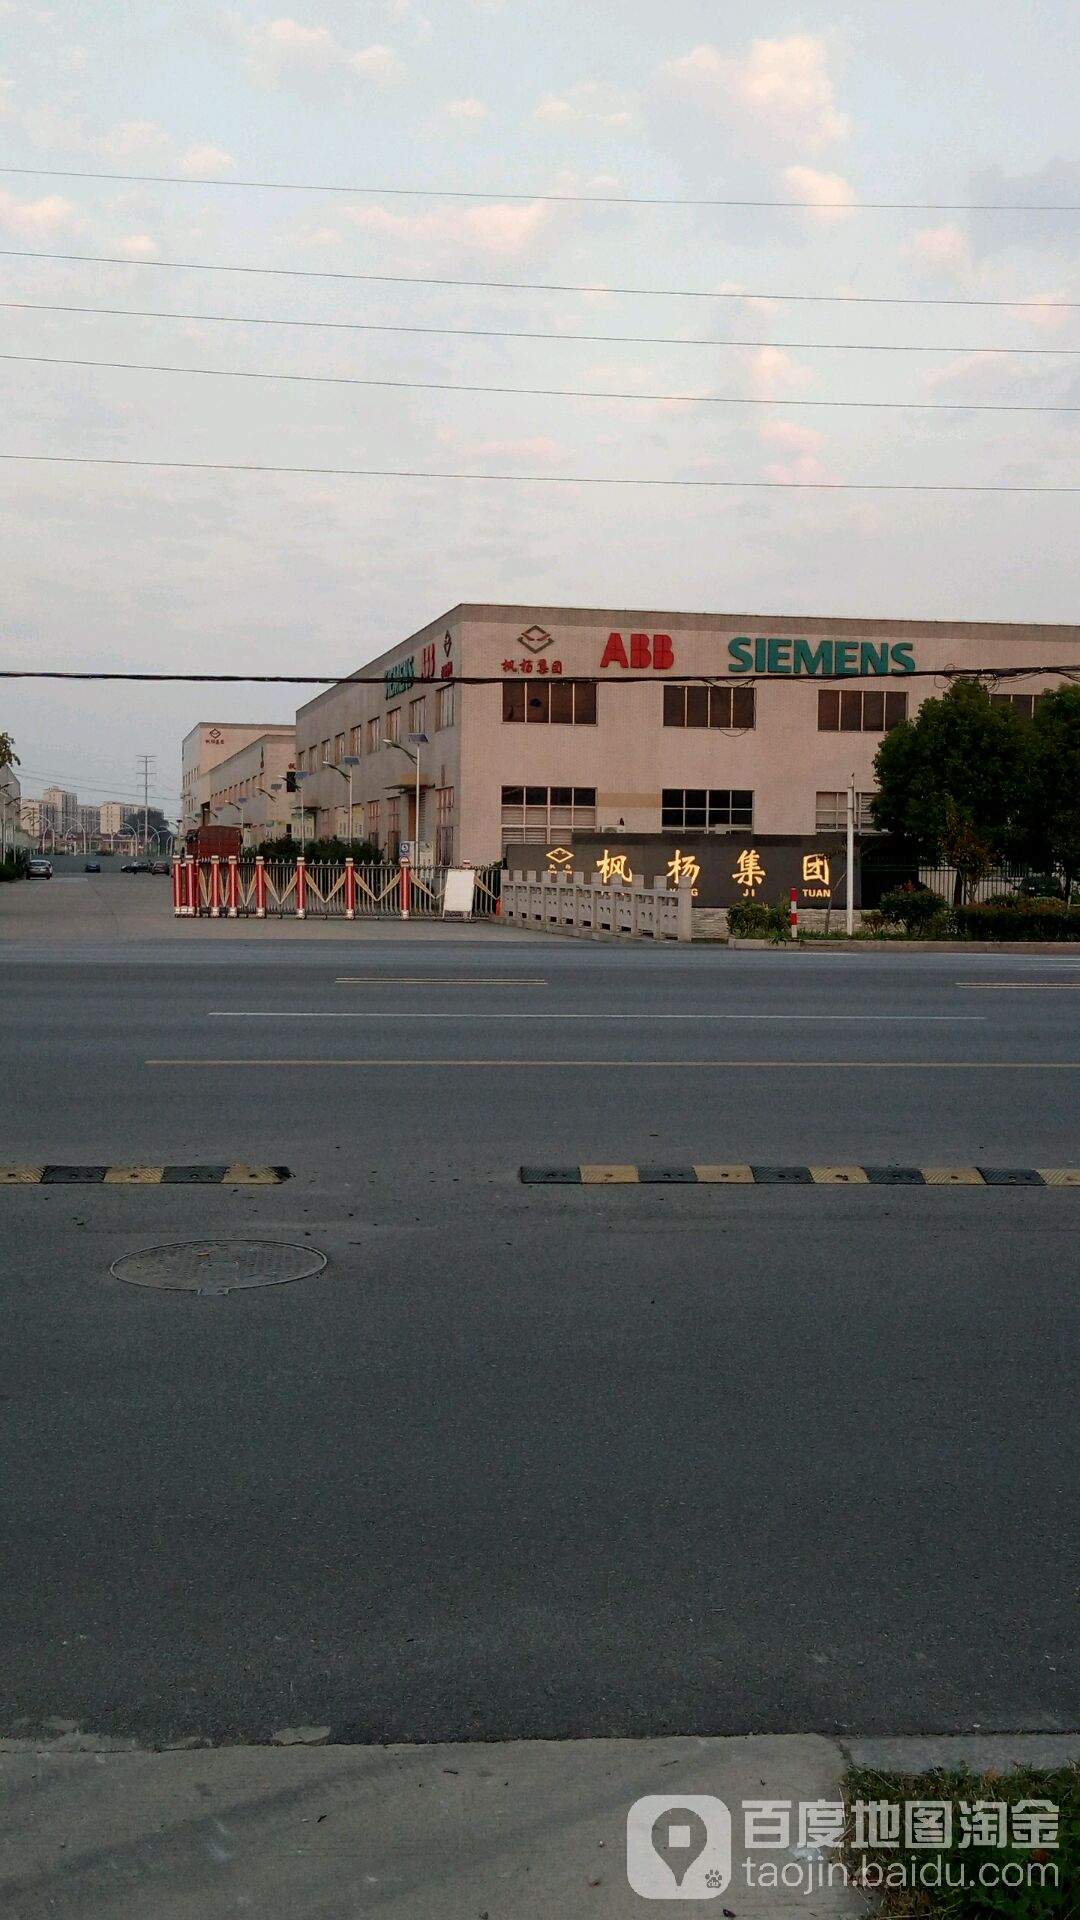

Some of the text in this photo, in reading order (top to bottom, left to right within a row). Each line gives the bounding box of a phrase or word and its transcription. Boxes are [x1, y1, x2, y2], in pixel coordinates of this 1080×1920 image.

[600, 633, 675, 670] ABB
[728, 637, 916, 677] SIEMENS
[596, 849, 832, 887] 枫杨集团
[743, 888, 831, 898] JI TUAN
